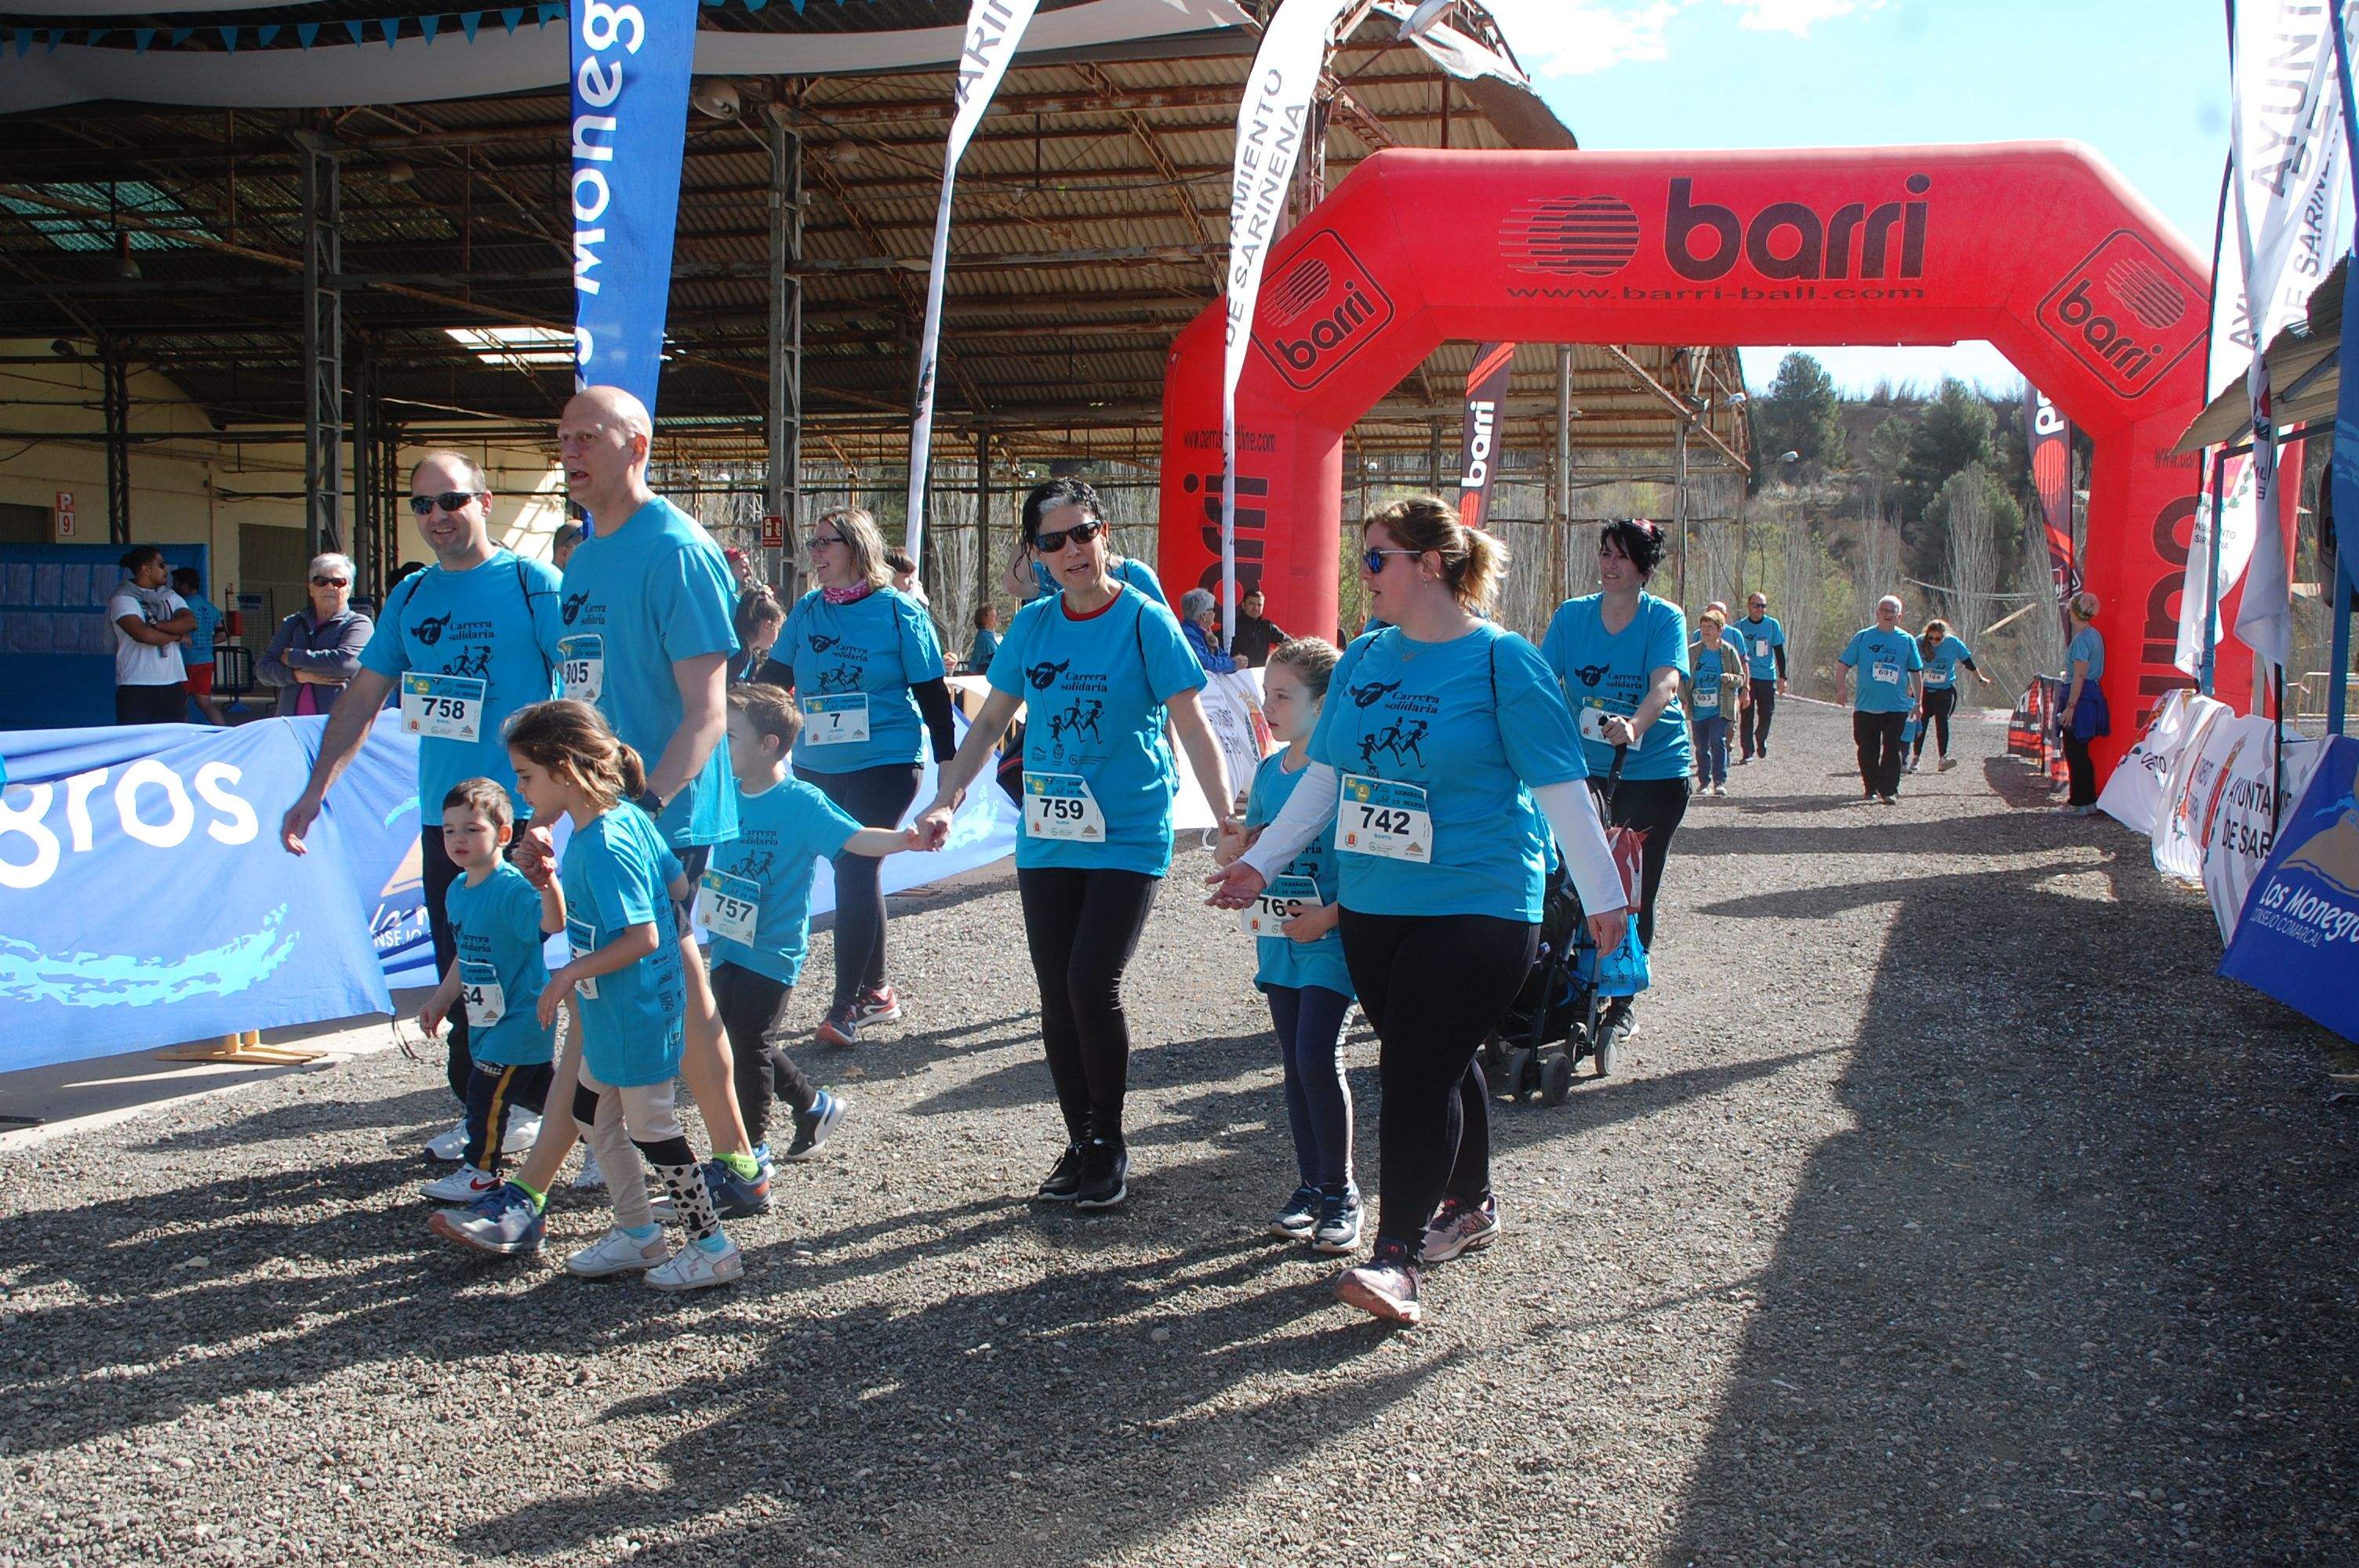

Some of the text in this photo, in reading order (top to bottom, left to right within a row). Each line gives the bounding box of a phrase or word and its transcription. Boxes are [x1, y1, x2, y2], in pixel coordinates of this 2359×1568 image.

[1663, 172, 1932, 282] barri
[1506, 285, 1925, 301] www.barri-ball.com
[1273, 279, 1377, 372] barri
[2056, 278, 2164, 382] barri
[1460, 401, 1495, 488] barri
[60, 493, 72, 510] P
[64, 514, 70, 533] 9
[450, 621, 493, 631] Carrera
[449, 630, 495, 641] solidaria
[831, 652, 867, 662] solidaria
[836, 644, 868, 654] Carrera
[1065, 671, 1107, 681] Carrera
[1060, 681, 1108, 692] solidaria
[1391, 691, 1440, 705] Carrera
[422, 698, 465, 720] 758
[1384, 702, 1438, 714] solidaria
[830, 713, 841, 728] 7
[1040, 798, 1084, 820] 759
[1361, 806, 1410, 835] 742
[741, 827, 777, 837] Carrera
[2222, 818, 2238, 850] DE
[740, 837, 778, 846] solidaria
[2259, 875, 2290, 909] Los
[715, 895, 753, 922] 757
